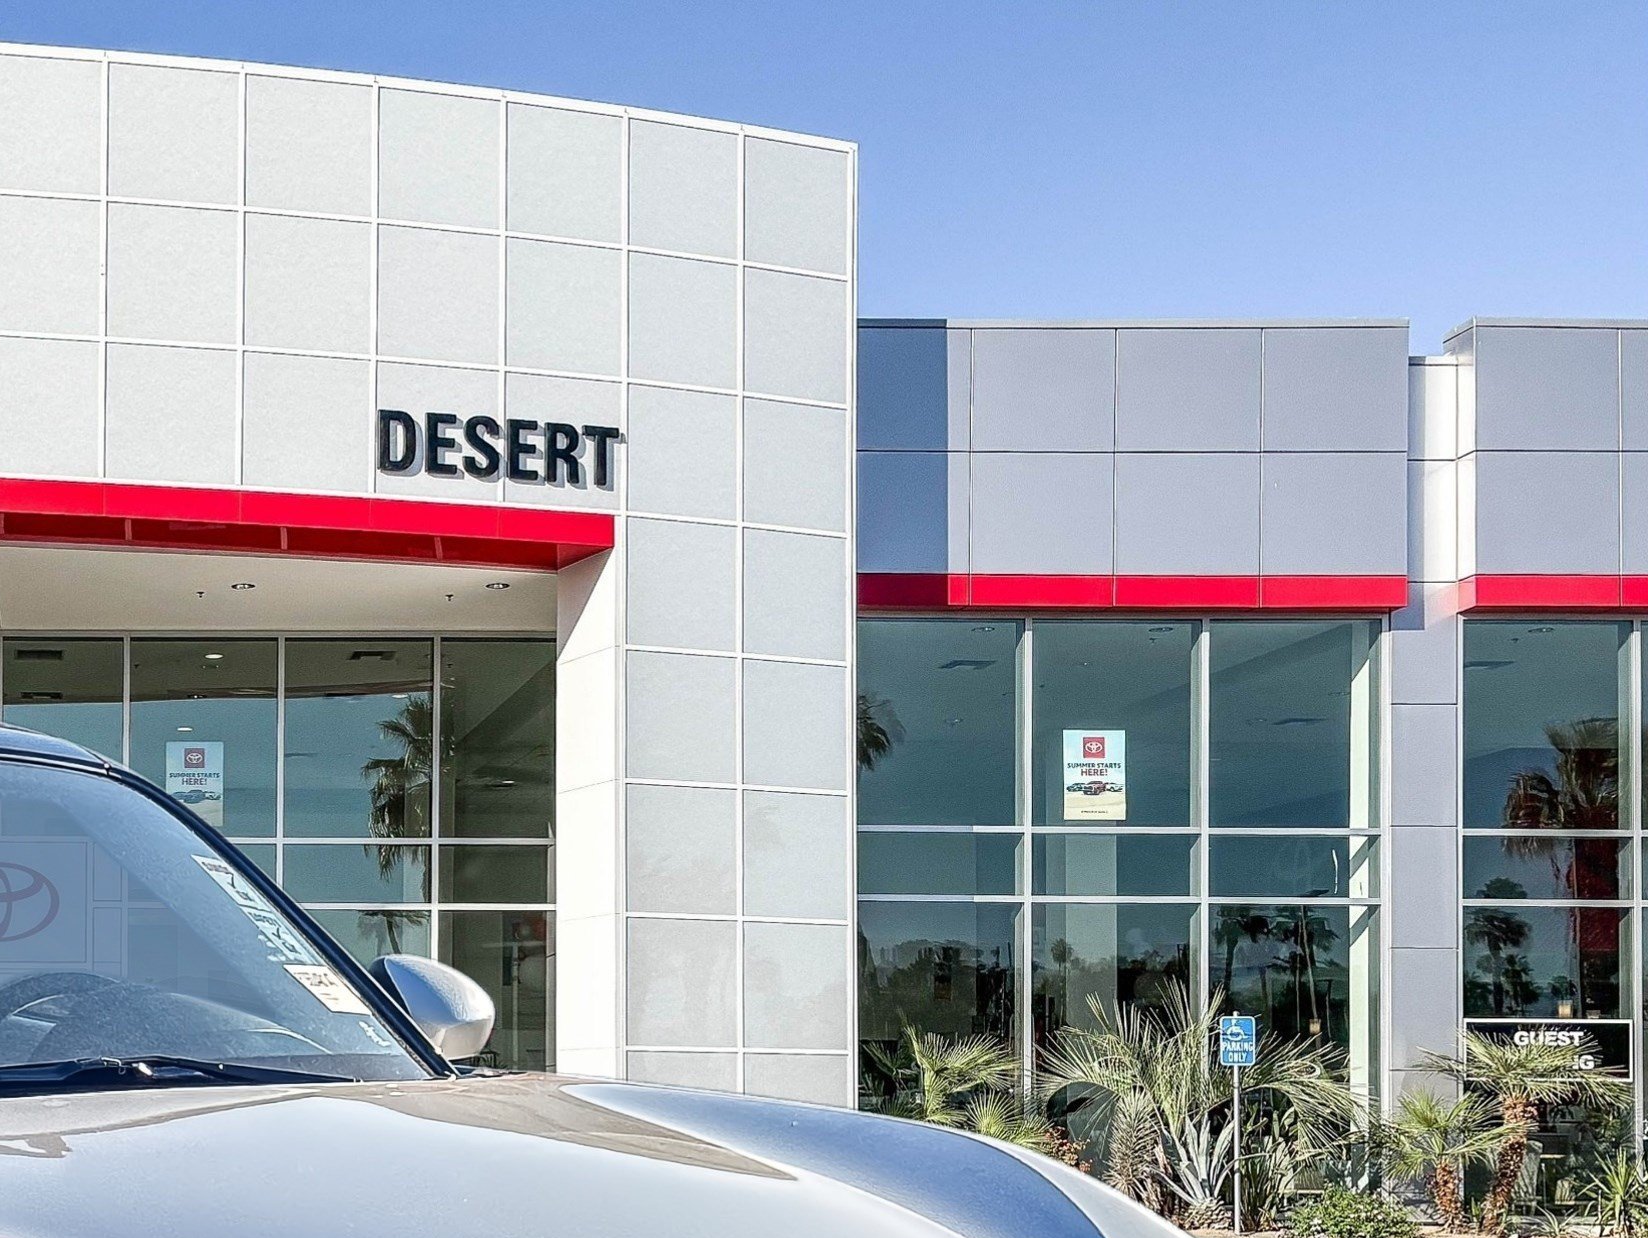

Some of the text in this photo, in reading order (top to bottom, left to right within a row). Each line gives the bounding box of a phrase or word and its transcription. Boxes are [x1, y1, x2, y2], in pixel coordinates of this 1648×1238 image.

[377, 409, 620, 487] DESERT
[1514, 1030, 1585, 1046] GUEST
[1222, 1041, 1253, 1051] PARKING
[1228, 1052, 1247, 1062] ONLY
